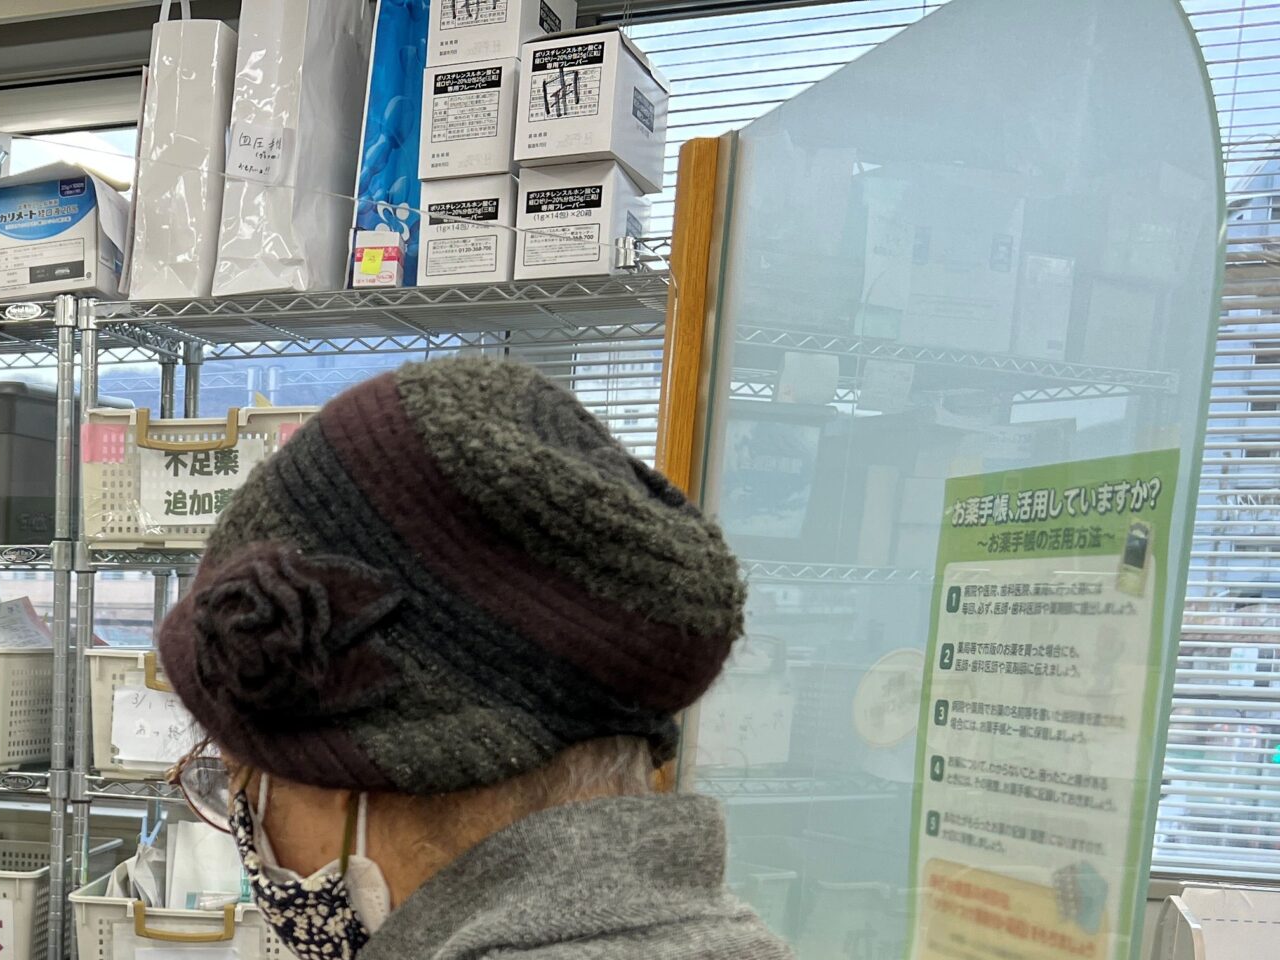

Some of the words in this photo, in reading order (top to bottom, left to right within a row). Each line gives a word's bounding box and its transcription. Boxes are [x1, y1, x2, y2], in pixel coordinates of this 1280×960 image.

[0, 210, 37, 223] カリメート
[164, 449, 239, 477] 不足薬
